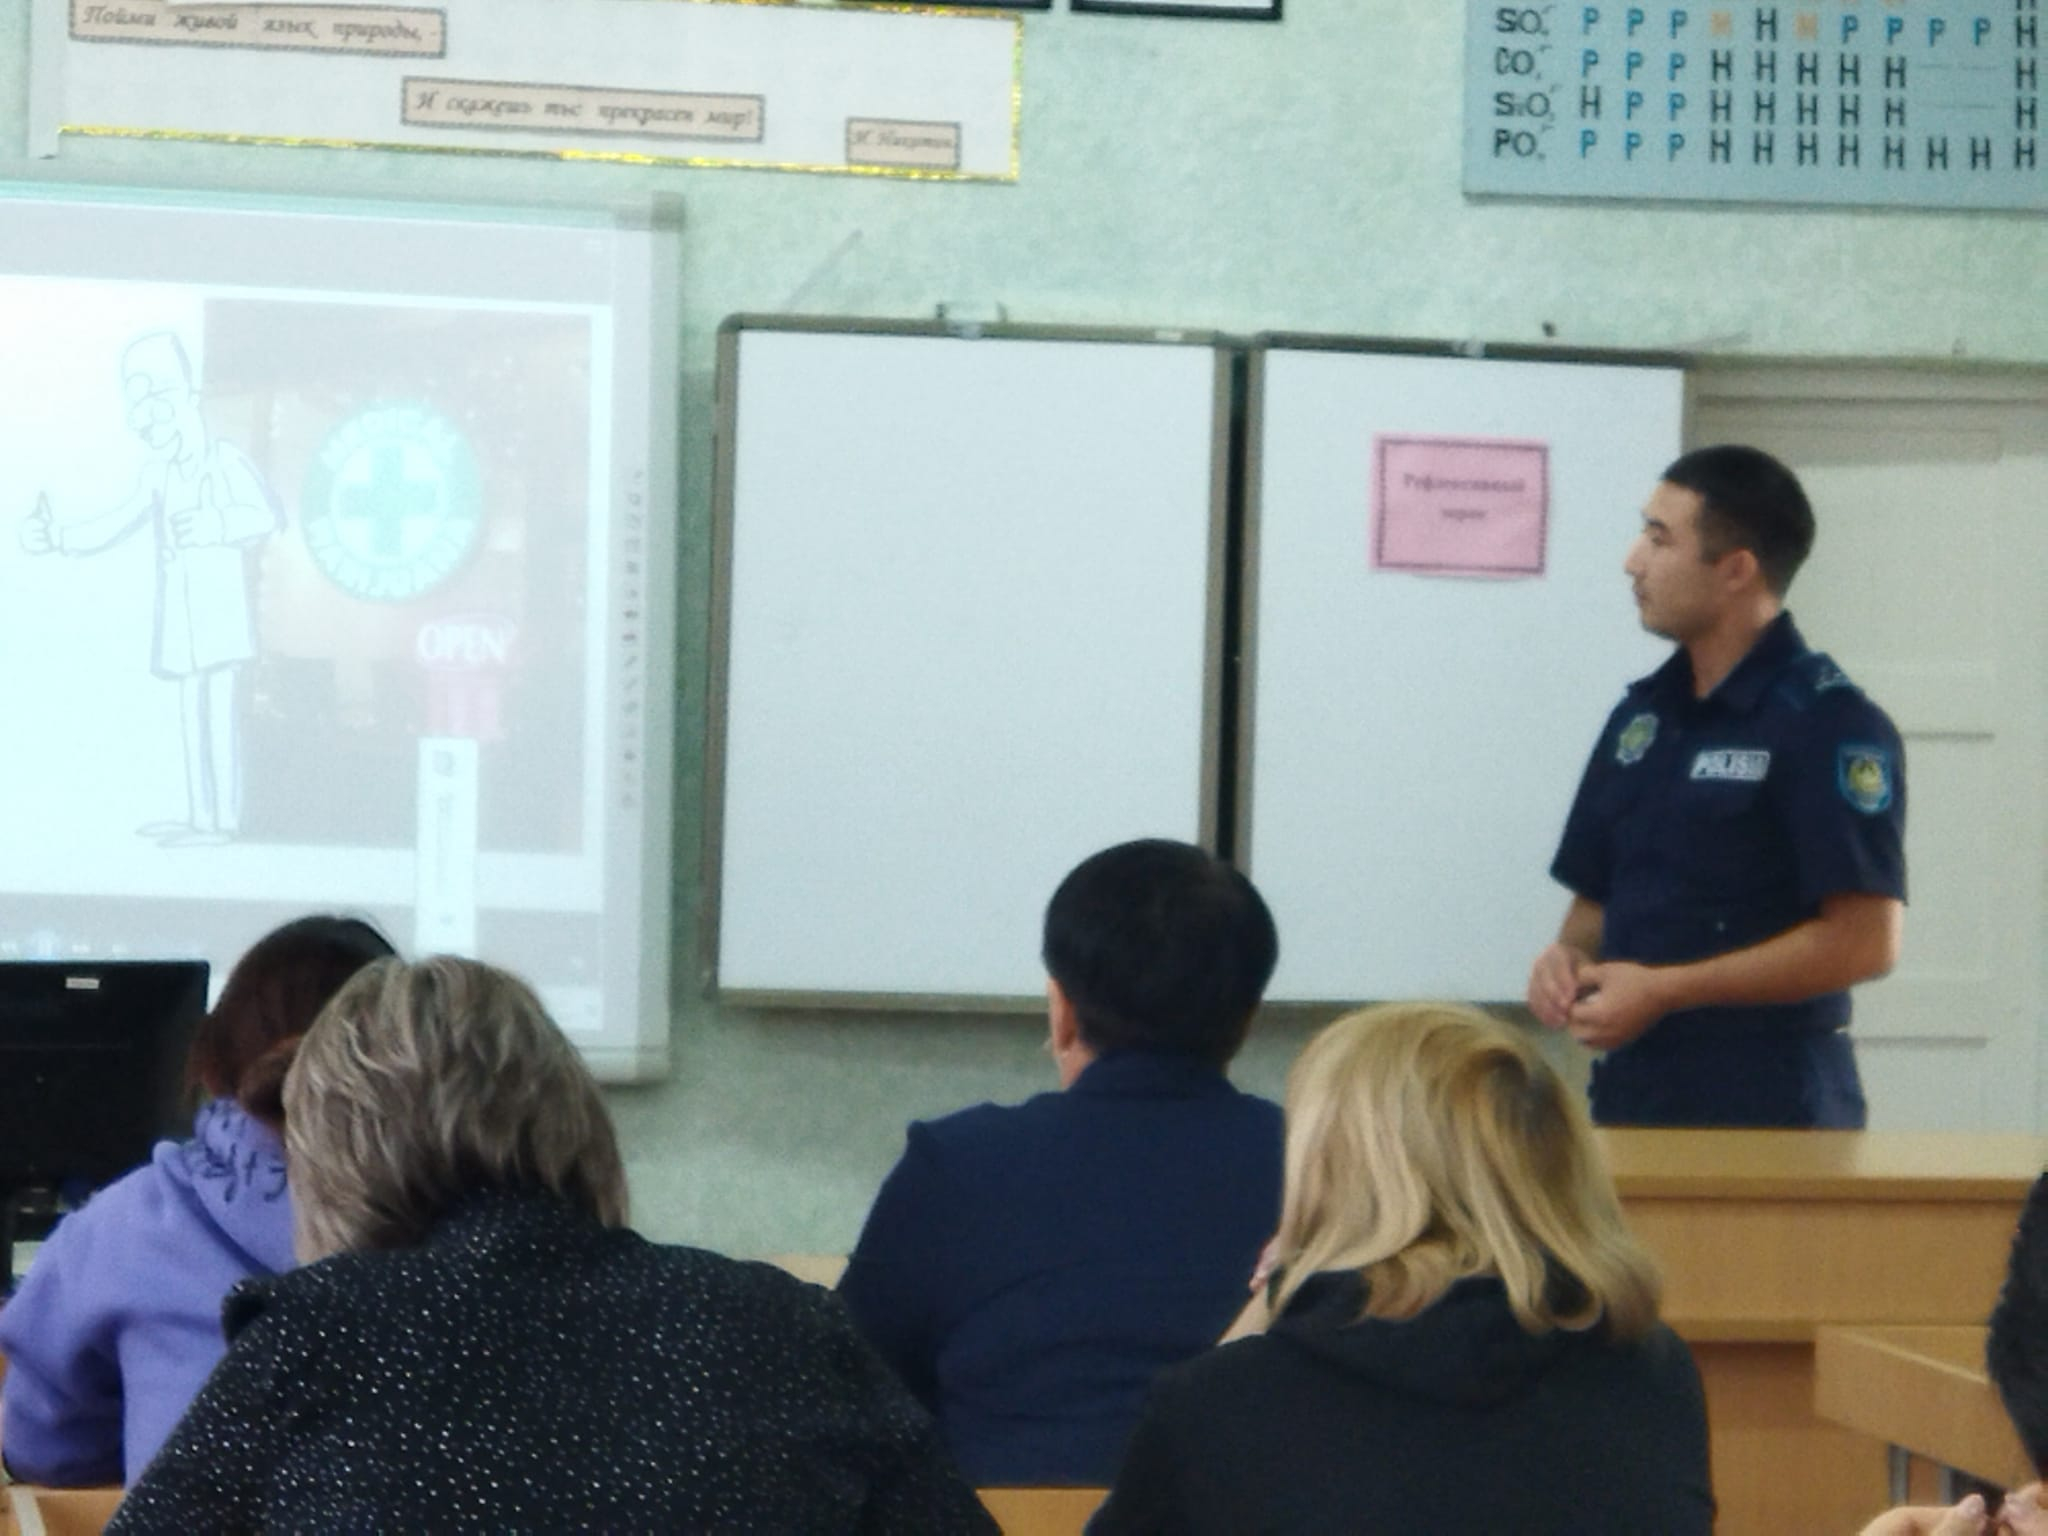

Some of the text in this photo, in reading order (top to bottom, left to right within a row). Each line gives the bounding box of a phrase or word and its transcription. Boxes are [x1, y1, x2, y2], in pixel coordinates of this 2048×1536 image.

[83, 5, 156, 26] Пойми
[174, 13, 238, 32] живой
[264, 19, 318, 38] язык
[417, 90, 439, 110] И
[446, 98, 532, 117] скажешь
[598, 105, 694, 126] прекрасен
[705, 109, 753, 131] мир!
[416, 622, 507, 664] OPEN
